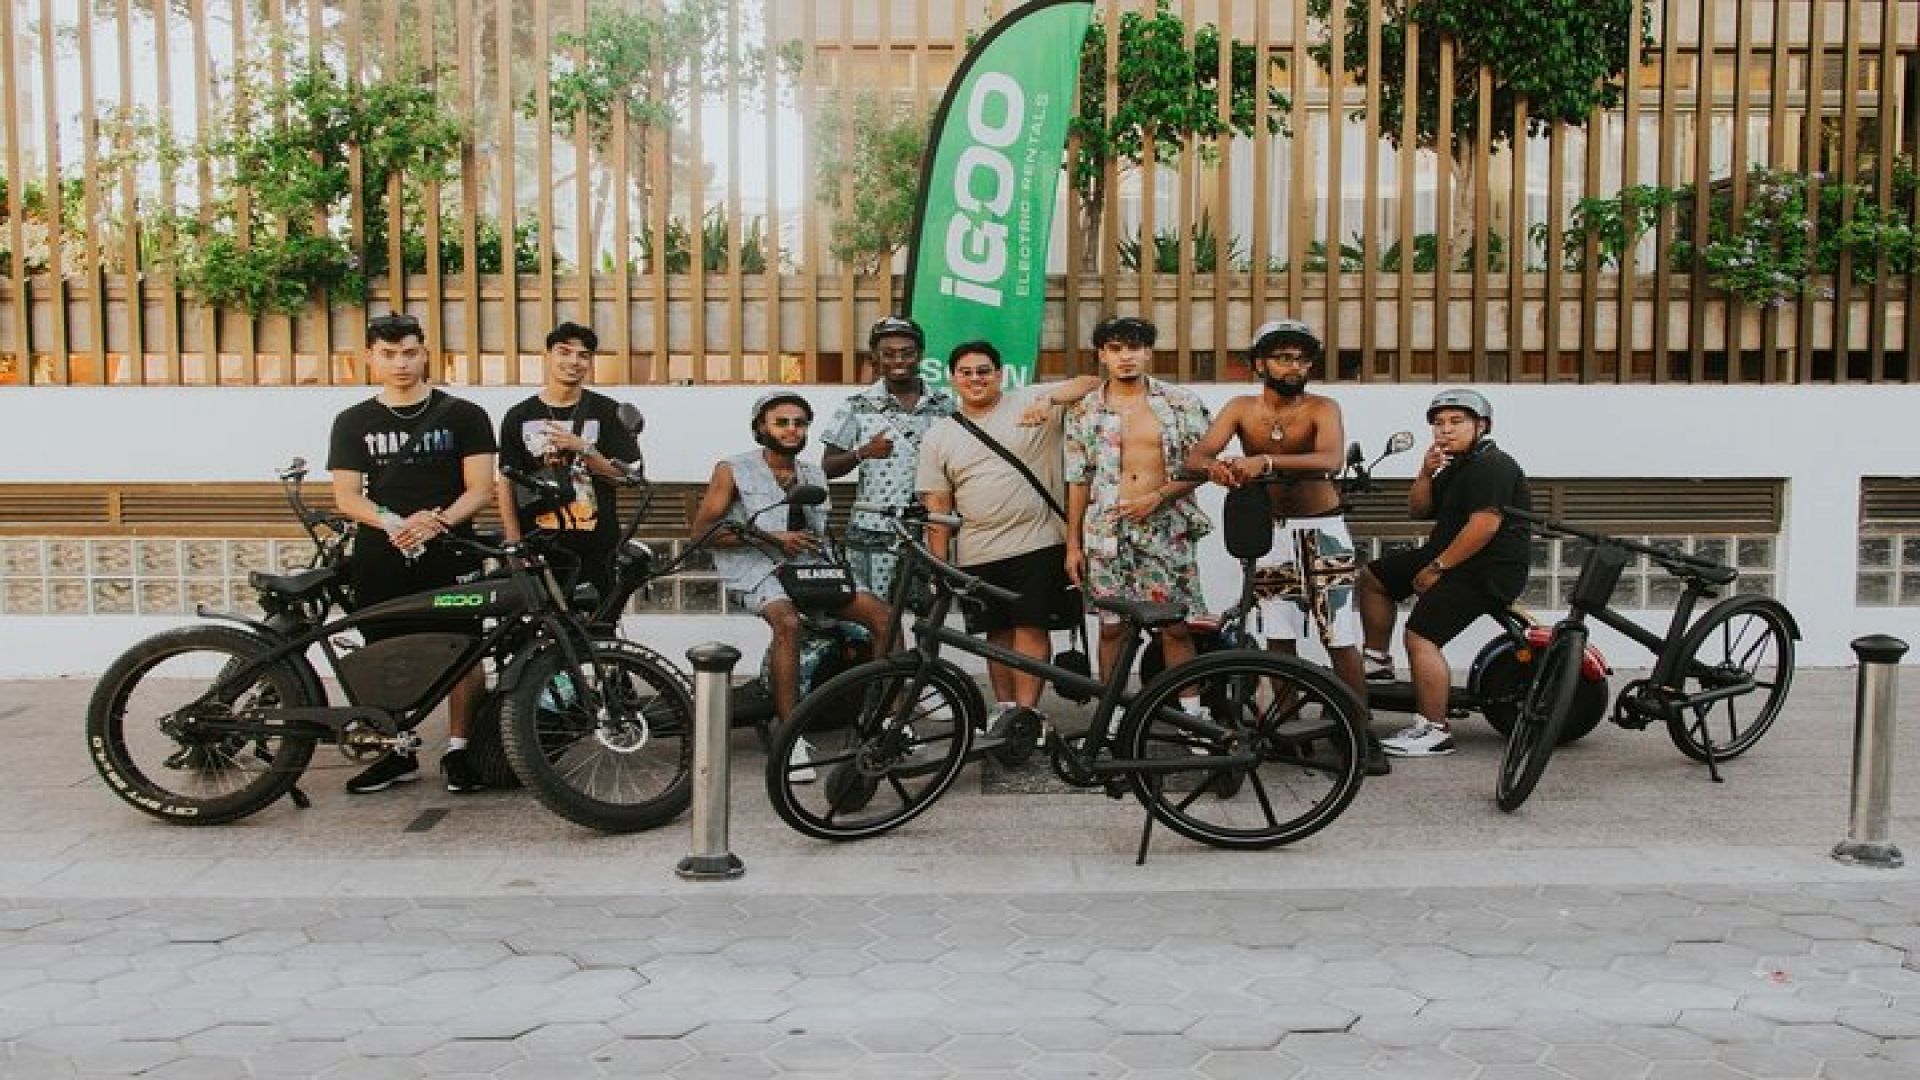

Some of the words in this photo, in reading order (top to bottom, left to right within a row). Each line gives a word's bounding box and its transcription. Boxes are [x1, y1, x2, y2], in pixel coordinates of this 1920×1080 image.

[1015, 201, 1031, 296] ELECTRIC
[1023, 91, 1049, 191] RENTALS
[919, 358, 1029, 388] SN
